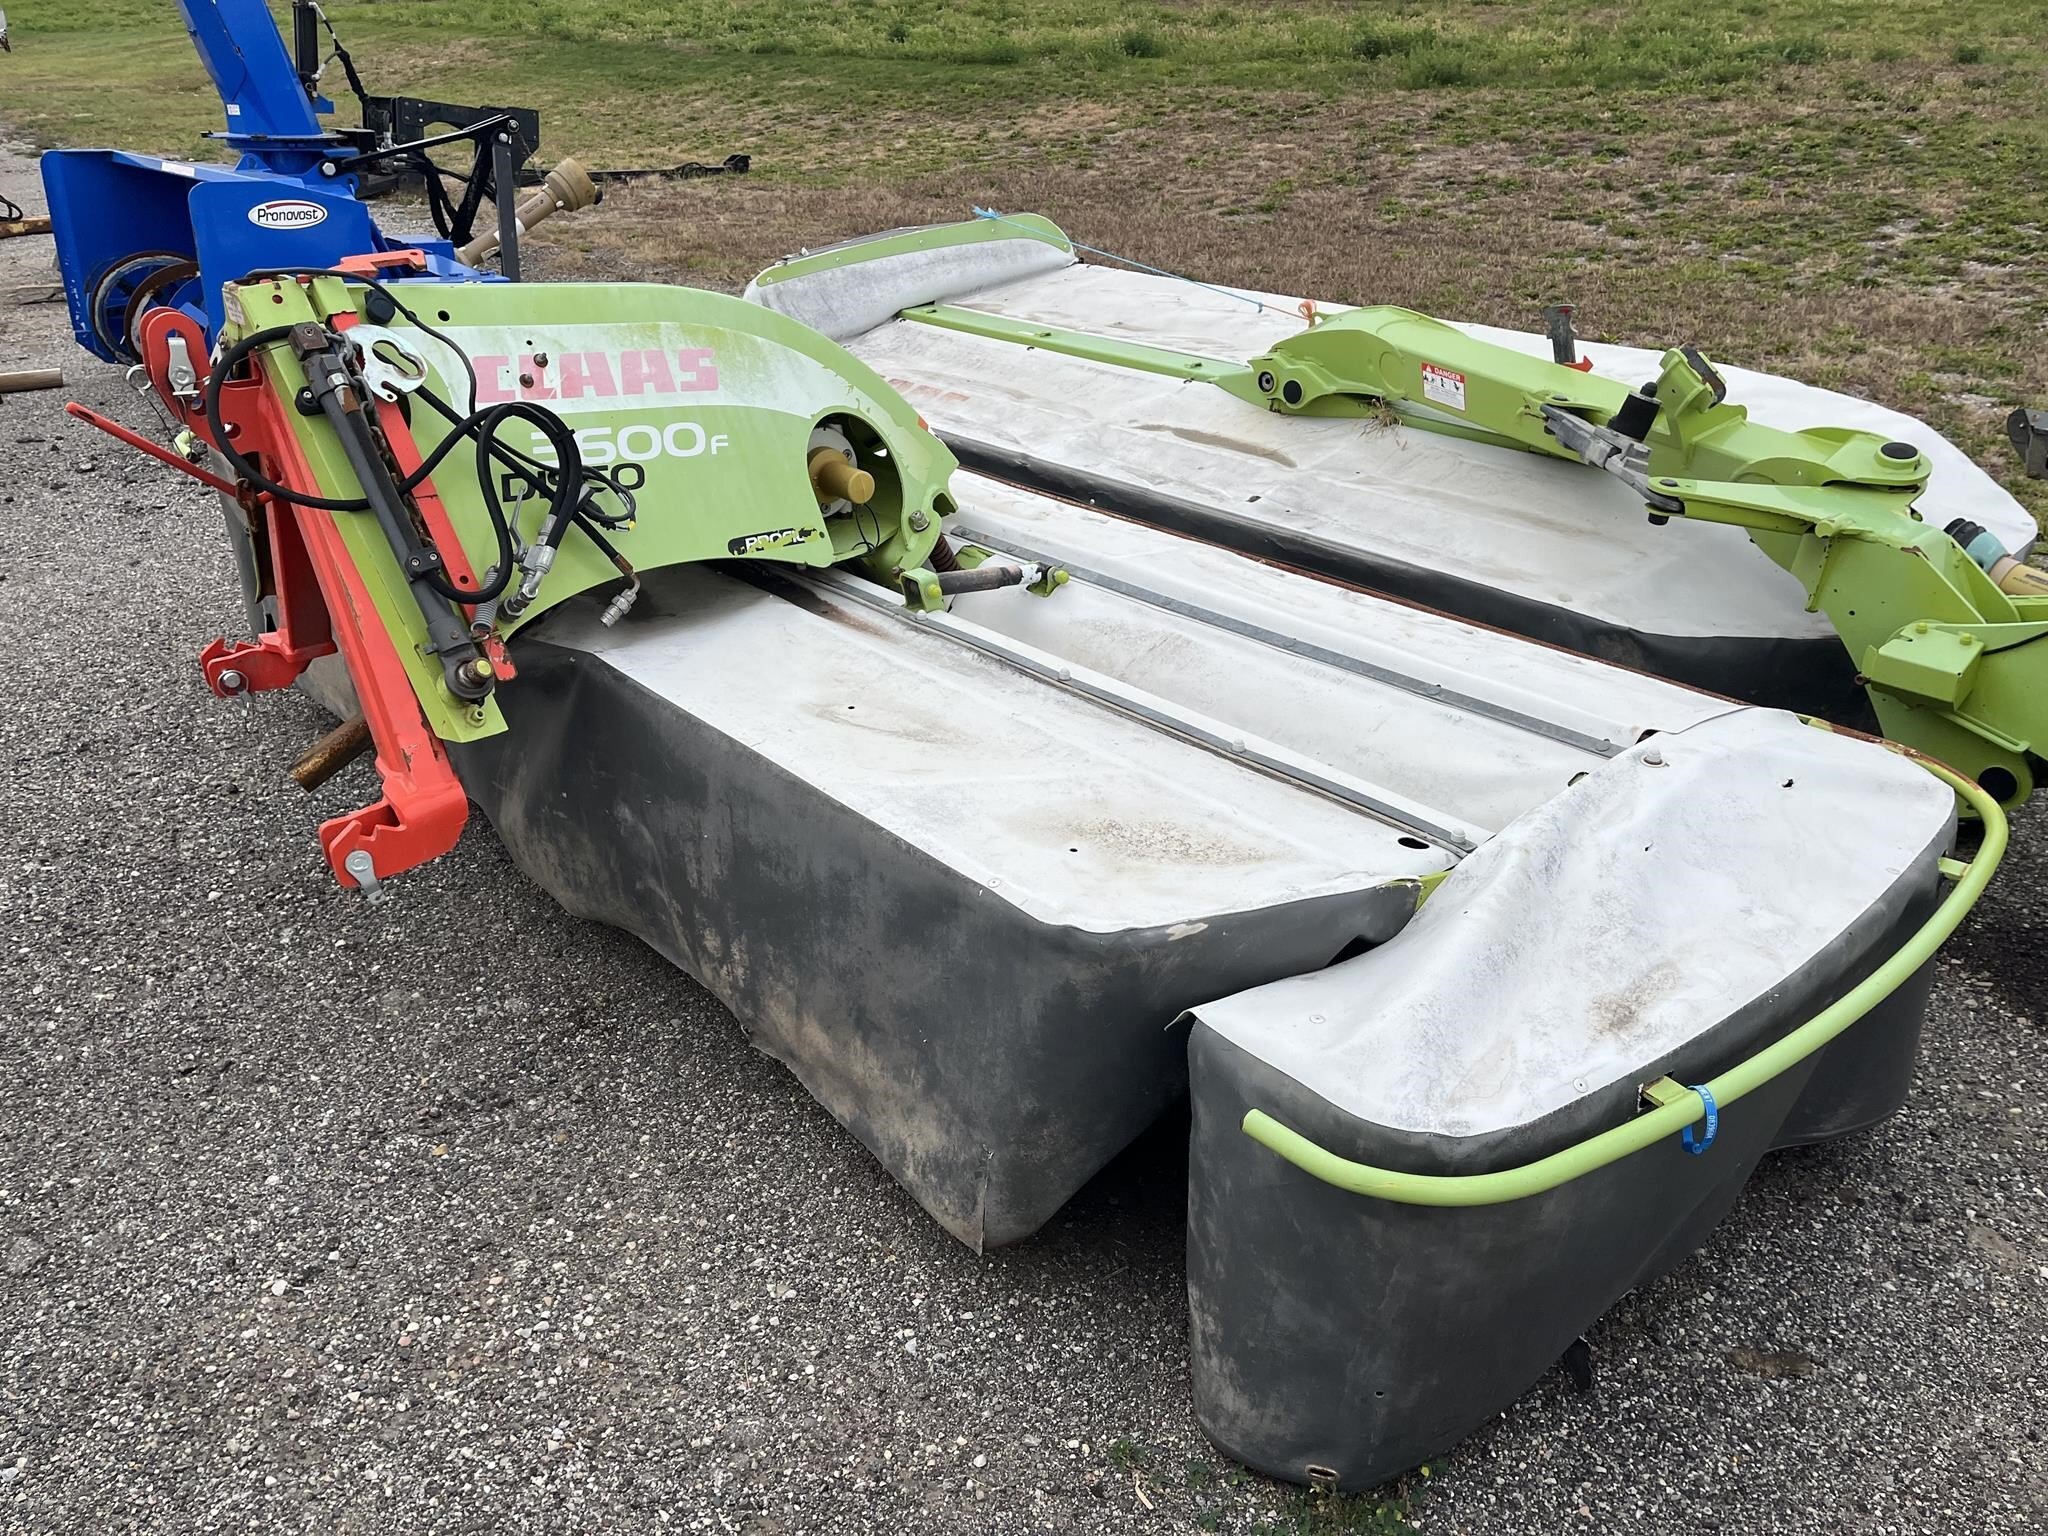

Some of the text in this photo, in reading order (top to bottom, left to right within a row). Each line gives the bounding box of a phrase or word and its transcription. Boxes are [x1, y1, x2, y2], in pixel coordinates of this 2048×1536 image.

[257, 208, 318, 222] Pronovost
[472, 347, 719, 403] CLAAS
[1434, 367, 1460, 381] DANGER
[501, 463, 645, 503] DIO
